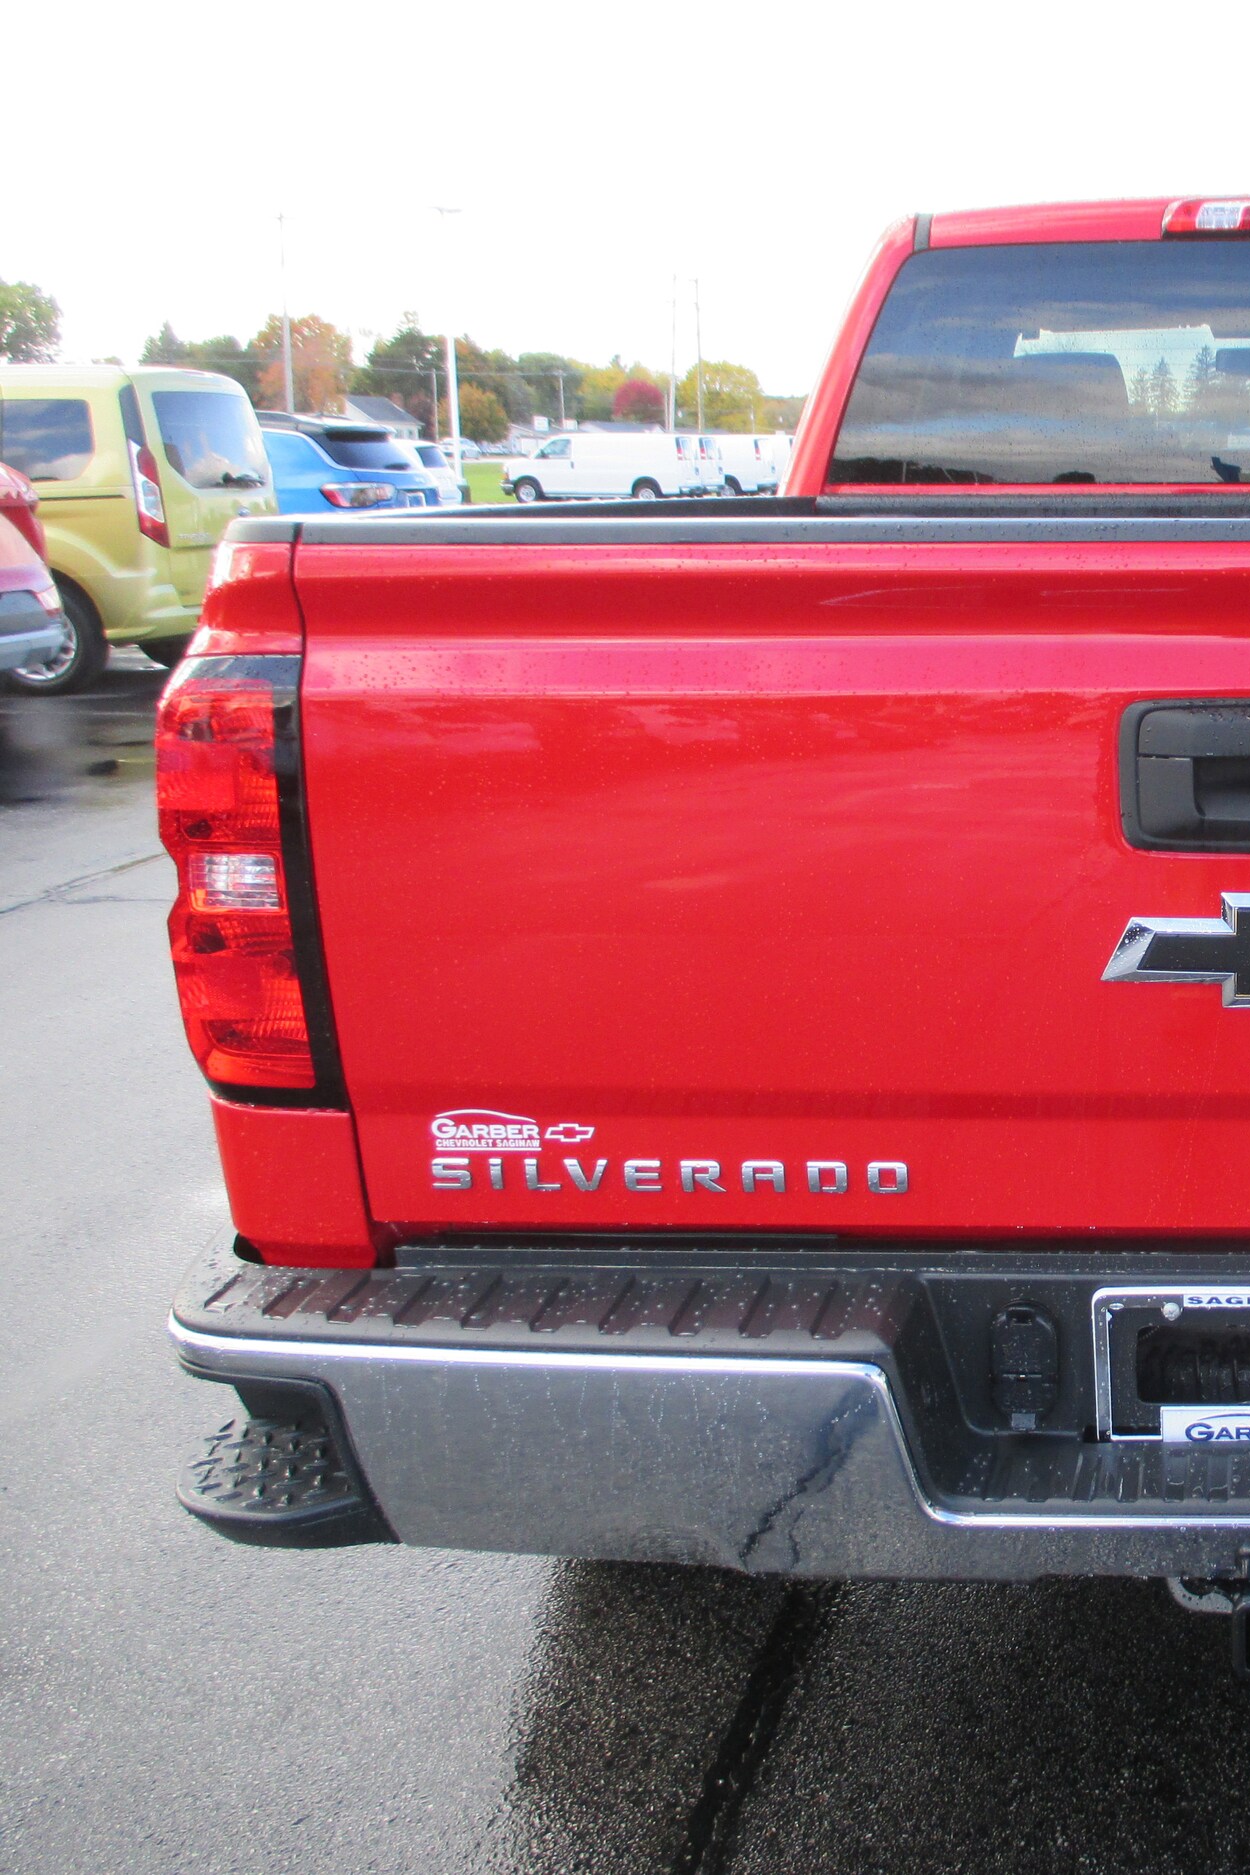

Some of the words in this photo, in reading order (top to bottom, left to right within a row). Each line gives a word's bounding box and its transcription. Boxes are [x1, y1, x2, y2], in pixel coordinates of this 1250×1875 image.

[431, 1118, 540, 1139] GARBER
[435, 1139, 493, 1148] CHEVROLET
[496, 1139, 540, 1148] SAGINAW
[431, 1157, 909, 1194] SILVERADO
